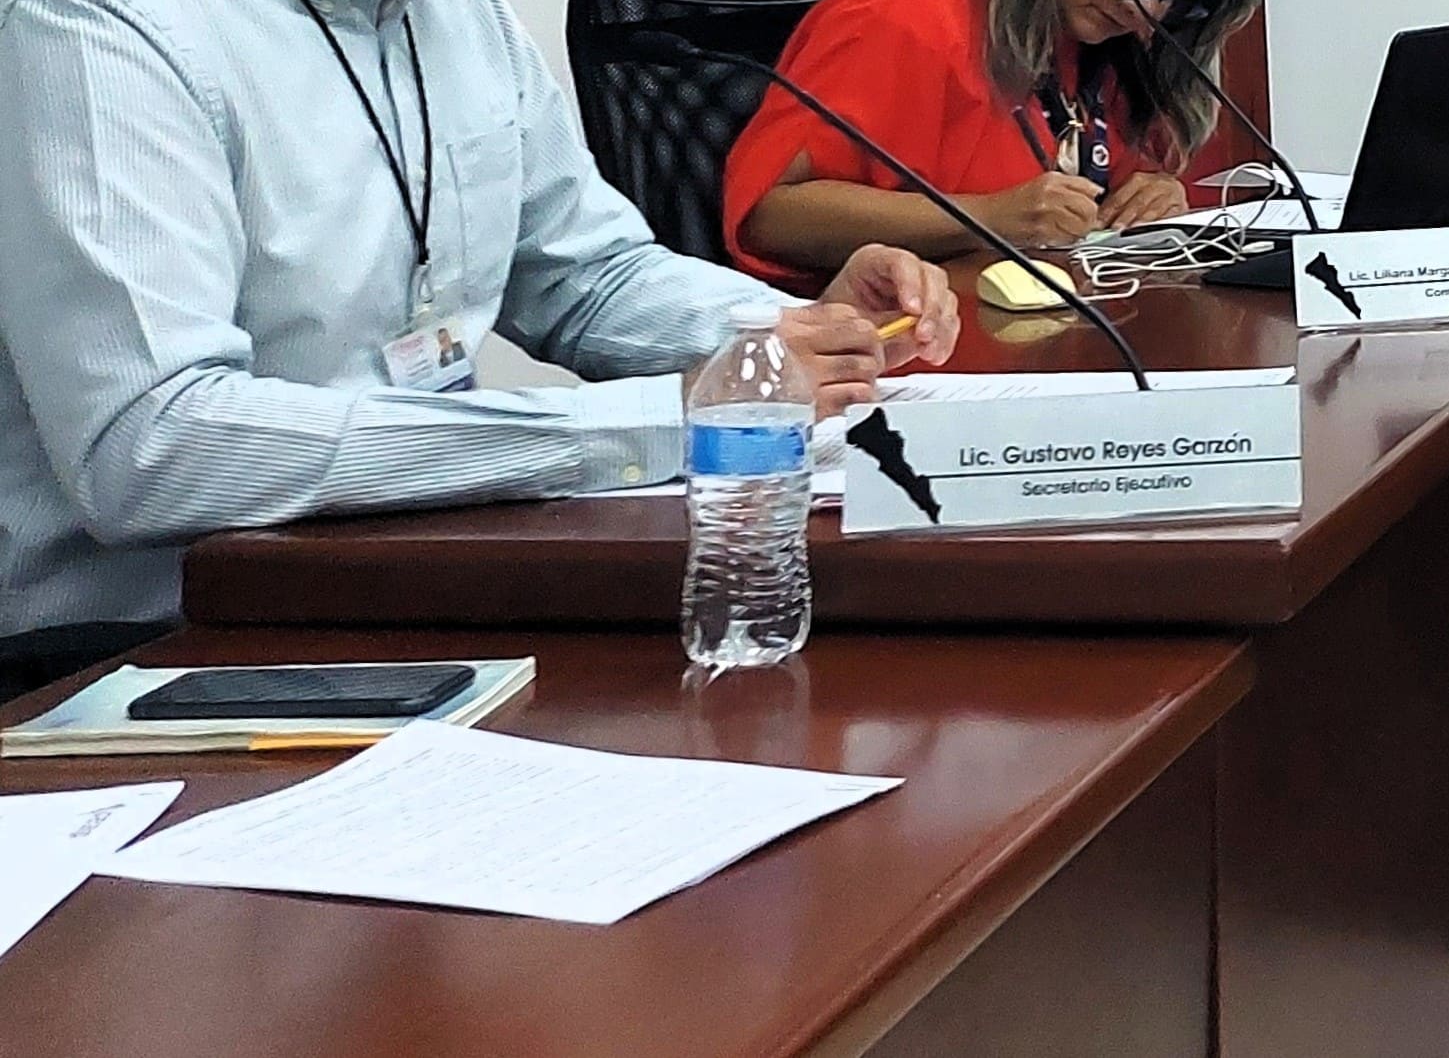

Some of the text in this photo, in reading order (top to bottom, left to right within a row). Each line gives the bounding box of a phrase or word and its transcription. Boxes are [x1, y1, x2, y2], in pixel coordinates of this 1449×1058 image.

[1374, 267, 1414, 280] Liliana
[959, 431, 1253, 467] Lic. Gustavo Reyes Garzón
[1022, 473, 1193, 497] Secretario Ejecutivo
